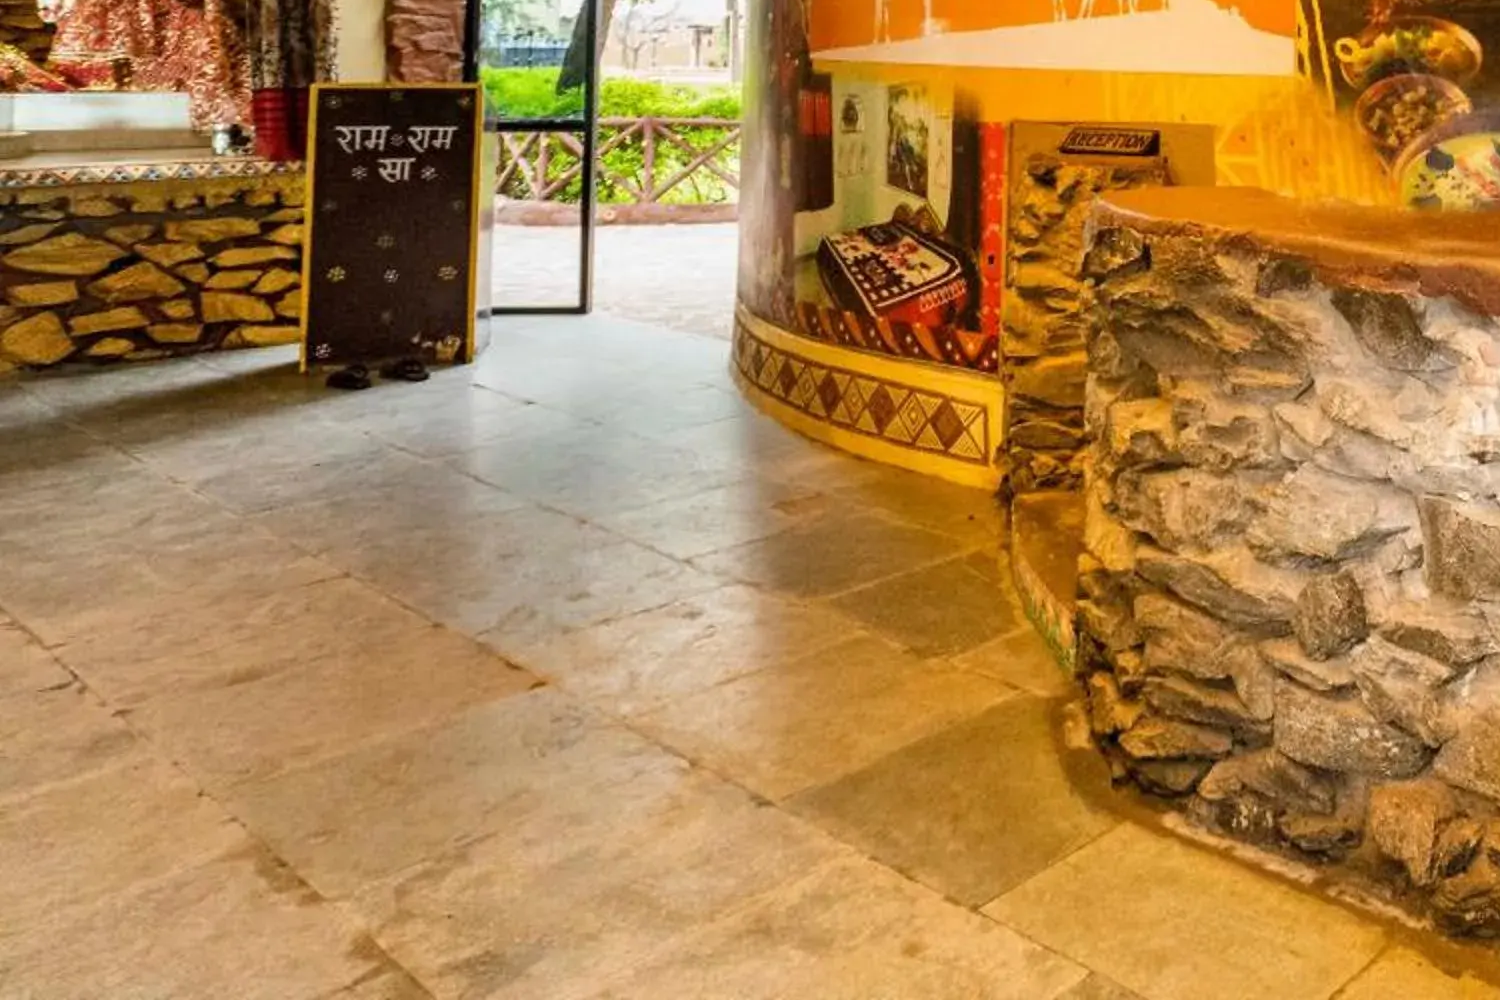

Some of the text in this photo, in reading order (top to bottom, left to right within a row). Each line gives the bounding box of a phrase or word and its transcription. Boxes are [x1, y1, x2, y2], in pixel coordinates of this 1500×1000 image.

[335, 125, 459, 154] राम राम
[377, 157, 416, 183] सा
